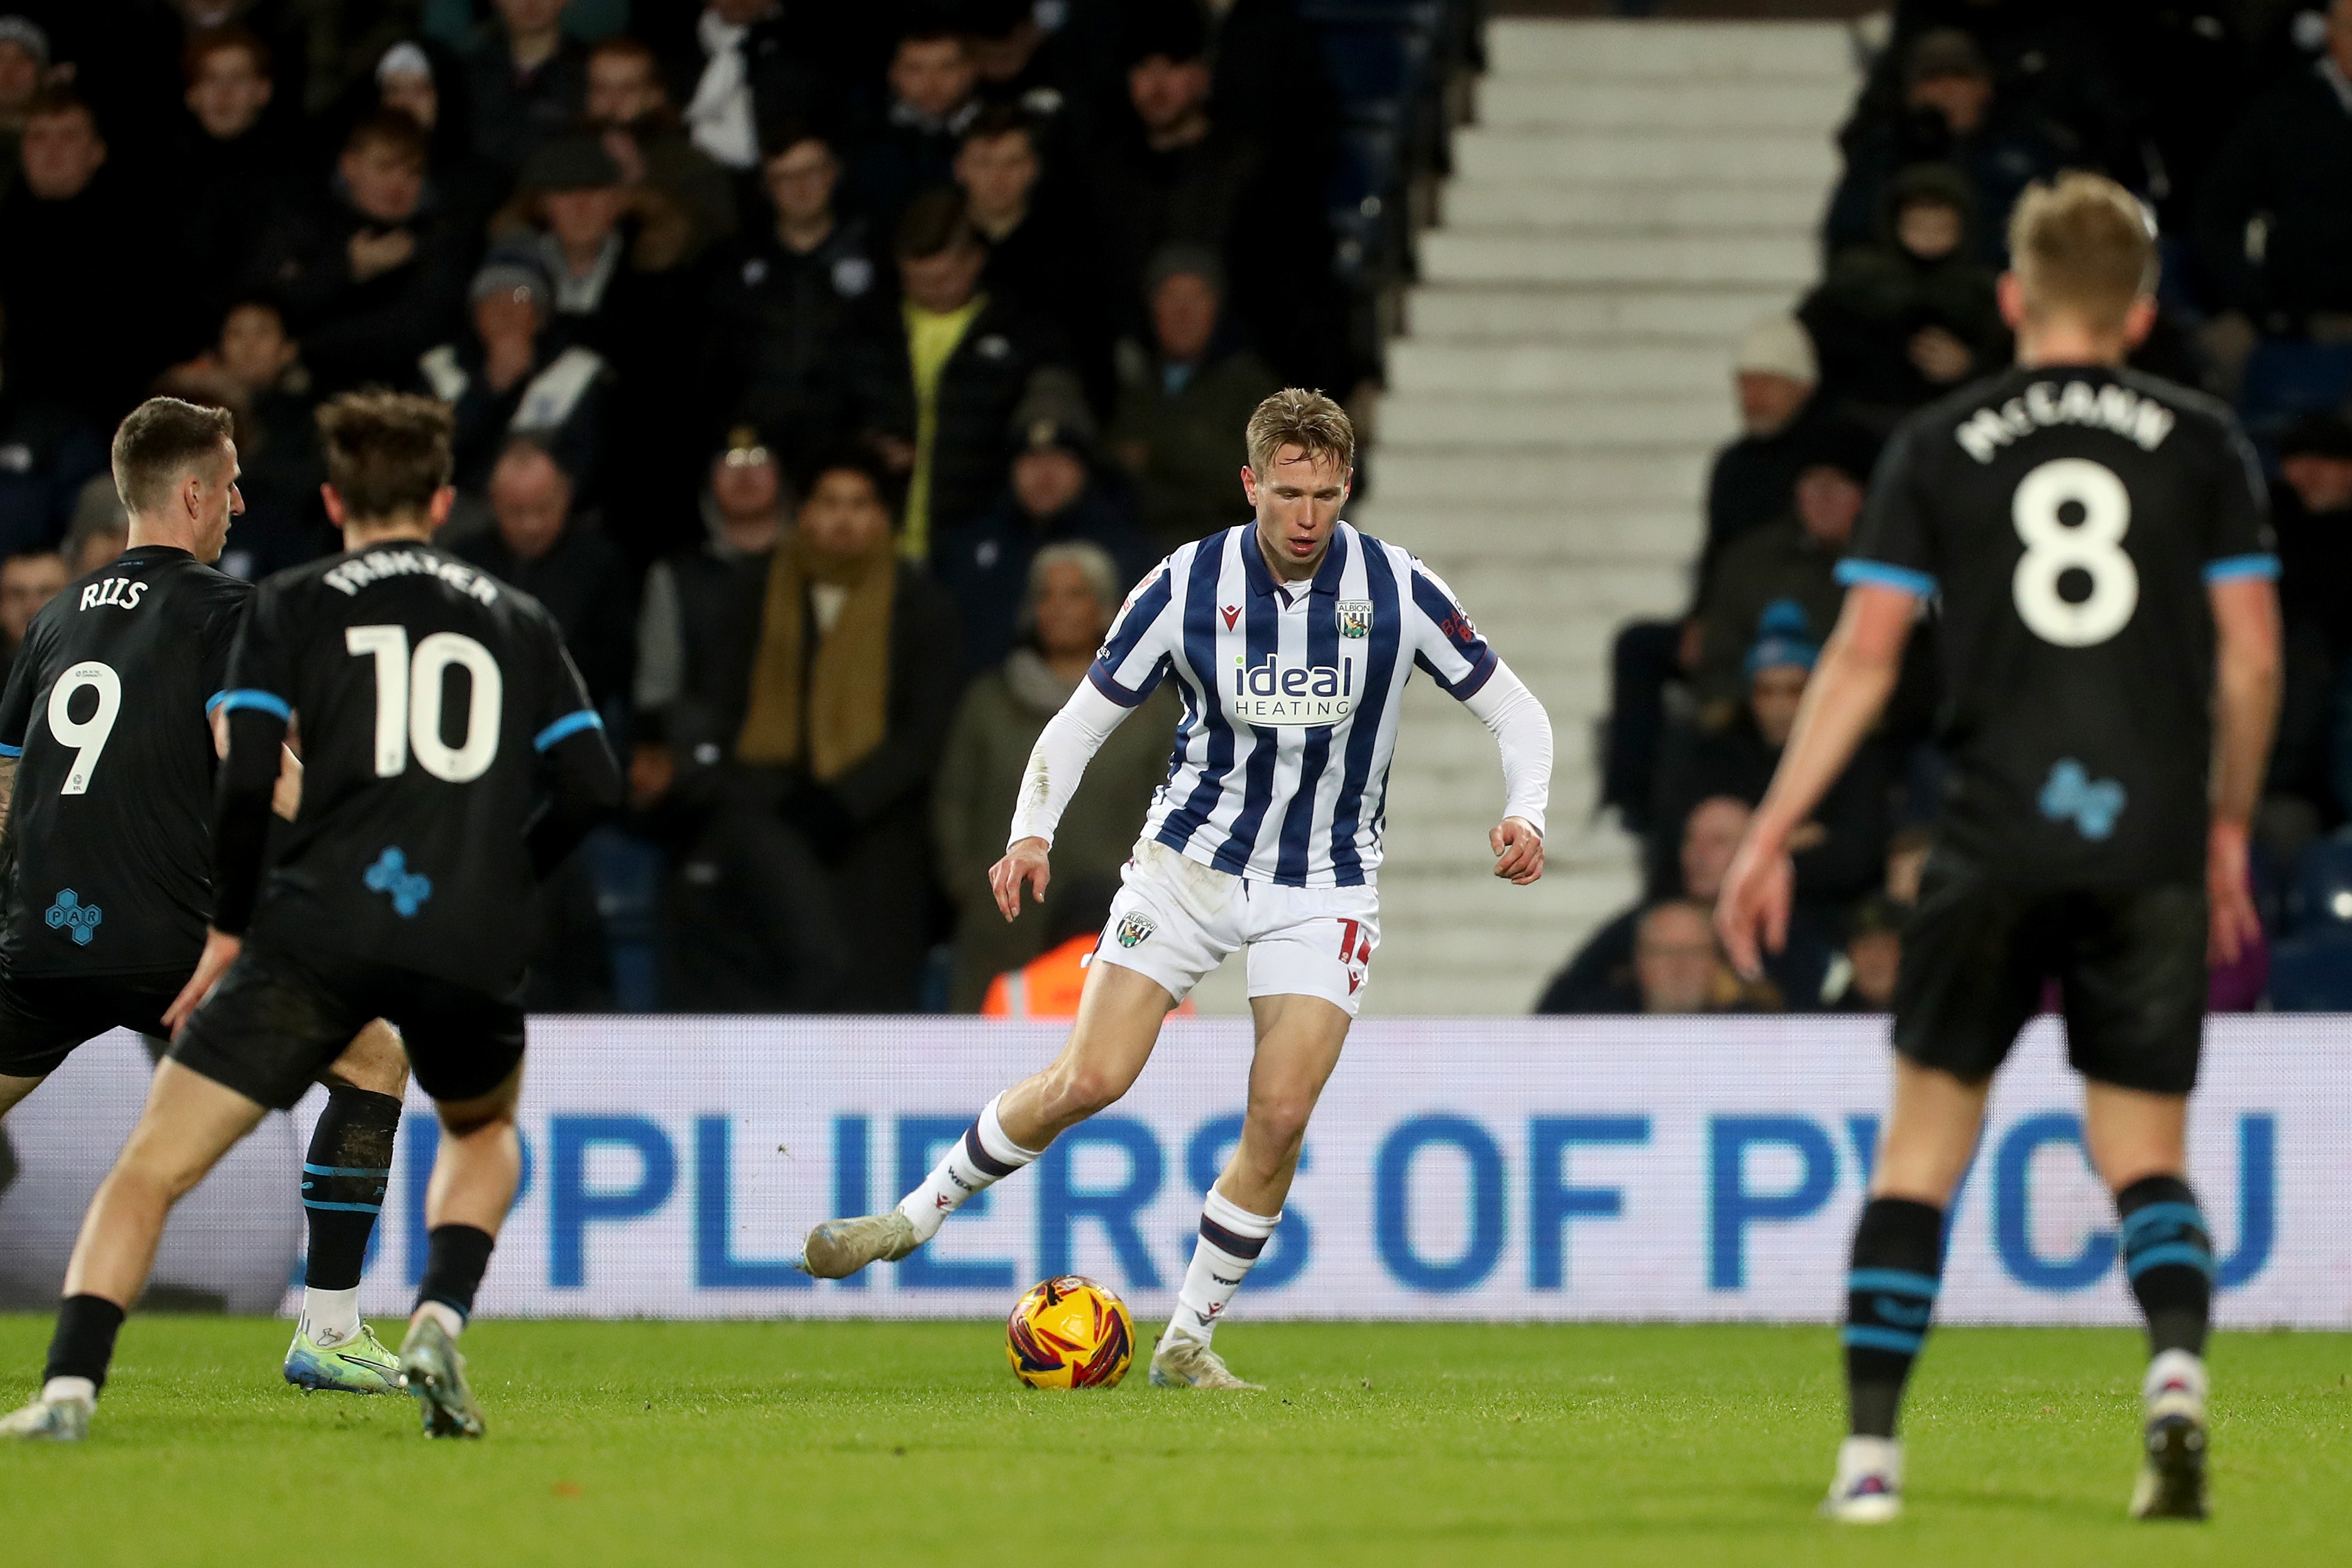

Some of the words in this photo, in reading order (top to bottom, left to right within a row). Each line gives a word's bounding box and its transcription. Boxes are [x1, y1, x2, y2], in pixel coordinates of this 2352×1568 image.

[2013, 458, 2138, 647] 8
[79, 578, 148, 611] RIIS
[1236, 655, 1351, 697] ideal
[345, 625, 502, 783] 10
[1236, 701, 1349, 716] HEATING
[48, 661, 121, 796] 9
[52, 911, 96, 922] PAR
[1125, 914, 1155, 929] ALBION
[1375, 1111, 1654, 1293] OF
